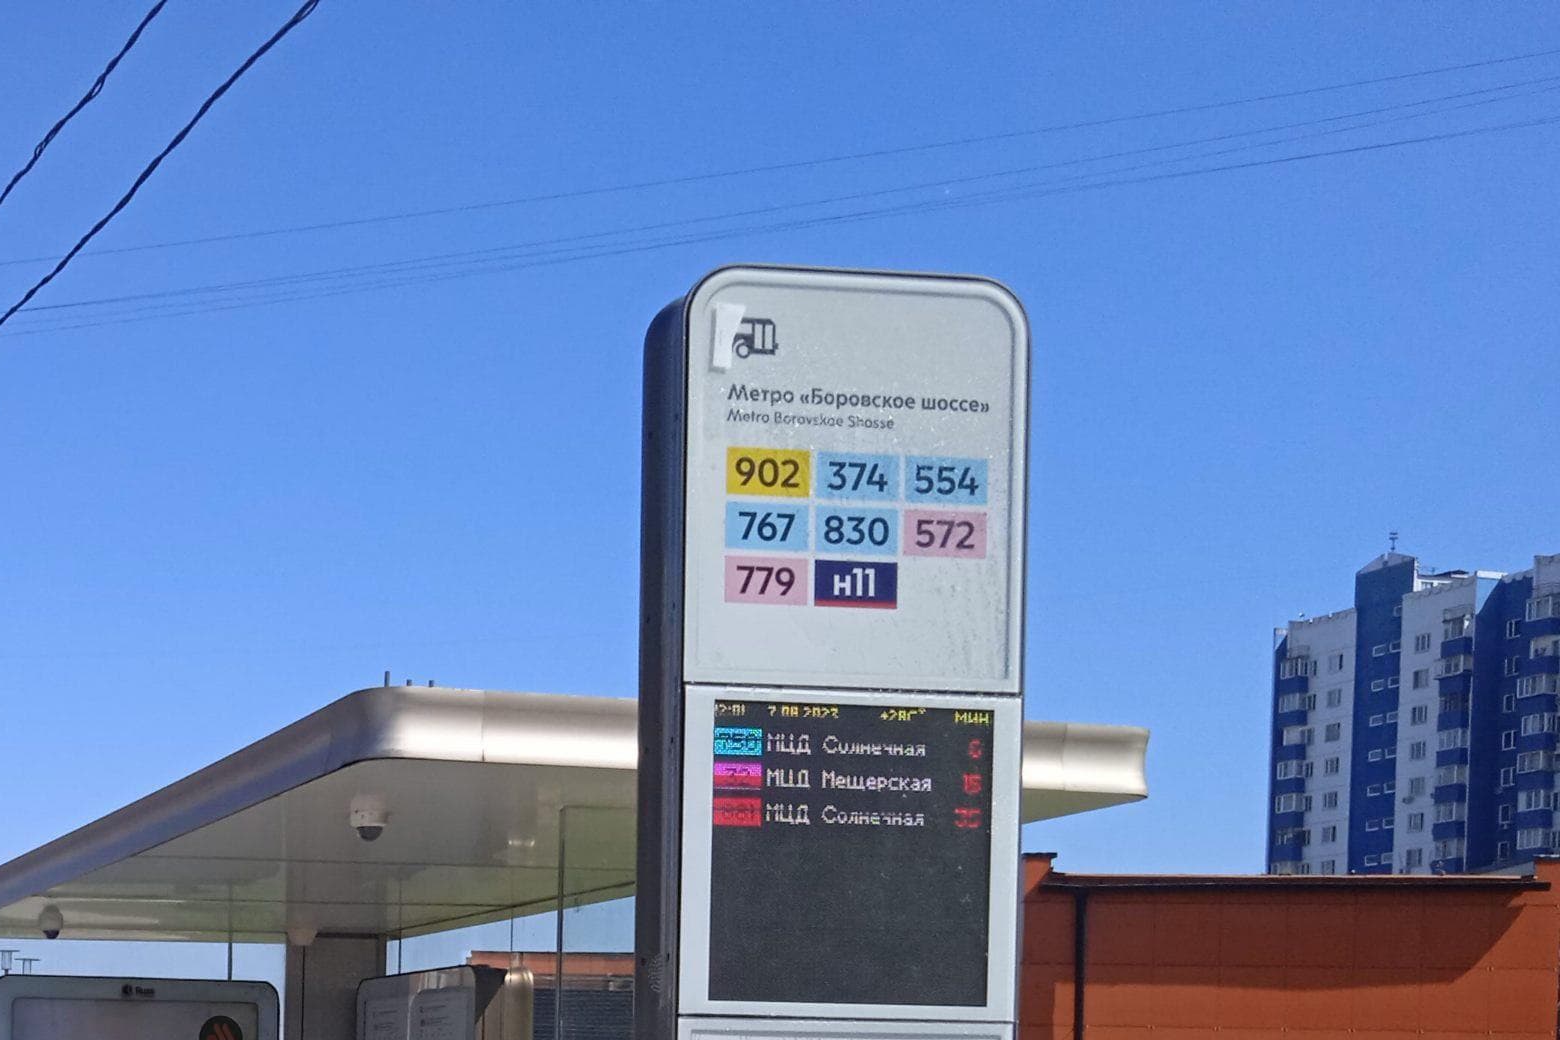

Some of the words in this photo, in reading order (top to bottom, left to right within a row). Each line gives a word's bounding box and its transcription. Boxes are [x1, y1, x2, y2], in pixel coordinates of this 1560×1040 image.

[727, 383, 794, 407] Метро
[800, 387, 916, 410] «Боровское
[921, 397, 990, 413] шоссе»
[727, 408, 769, 424] Metro
[848, 415, 895, 430] Shosse
[735, 457, 800, 488] 902
[827, 461, 888, 492] 374
[915, 464, 979, 496] 554
[739, 511, 796, 542] 767
[824, 515, 889, 546] 830
[915, 519, 975, 550] 572
[736, 565, 795, 596] 779
[833, 568, 876, 597] н11
[766, 732, 811, 755] МЦД
[821, 734, 927, 757] Солнечная
[766, 767, 811, 789] МЦД
[821, 769, 932, 793] Мещерская
[766, 802, 811, 825] МЦД
[821, 804, 925, 827] Солнечная
